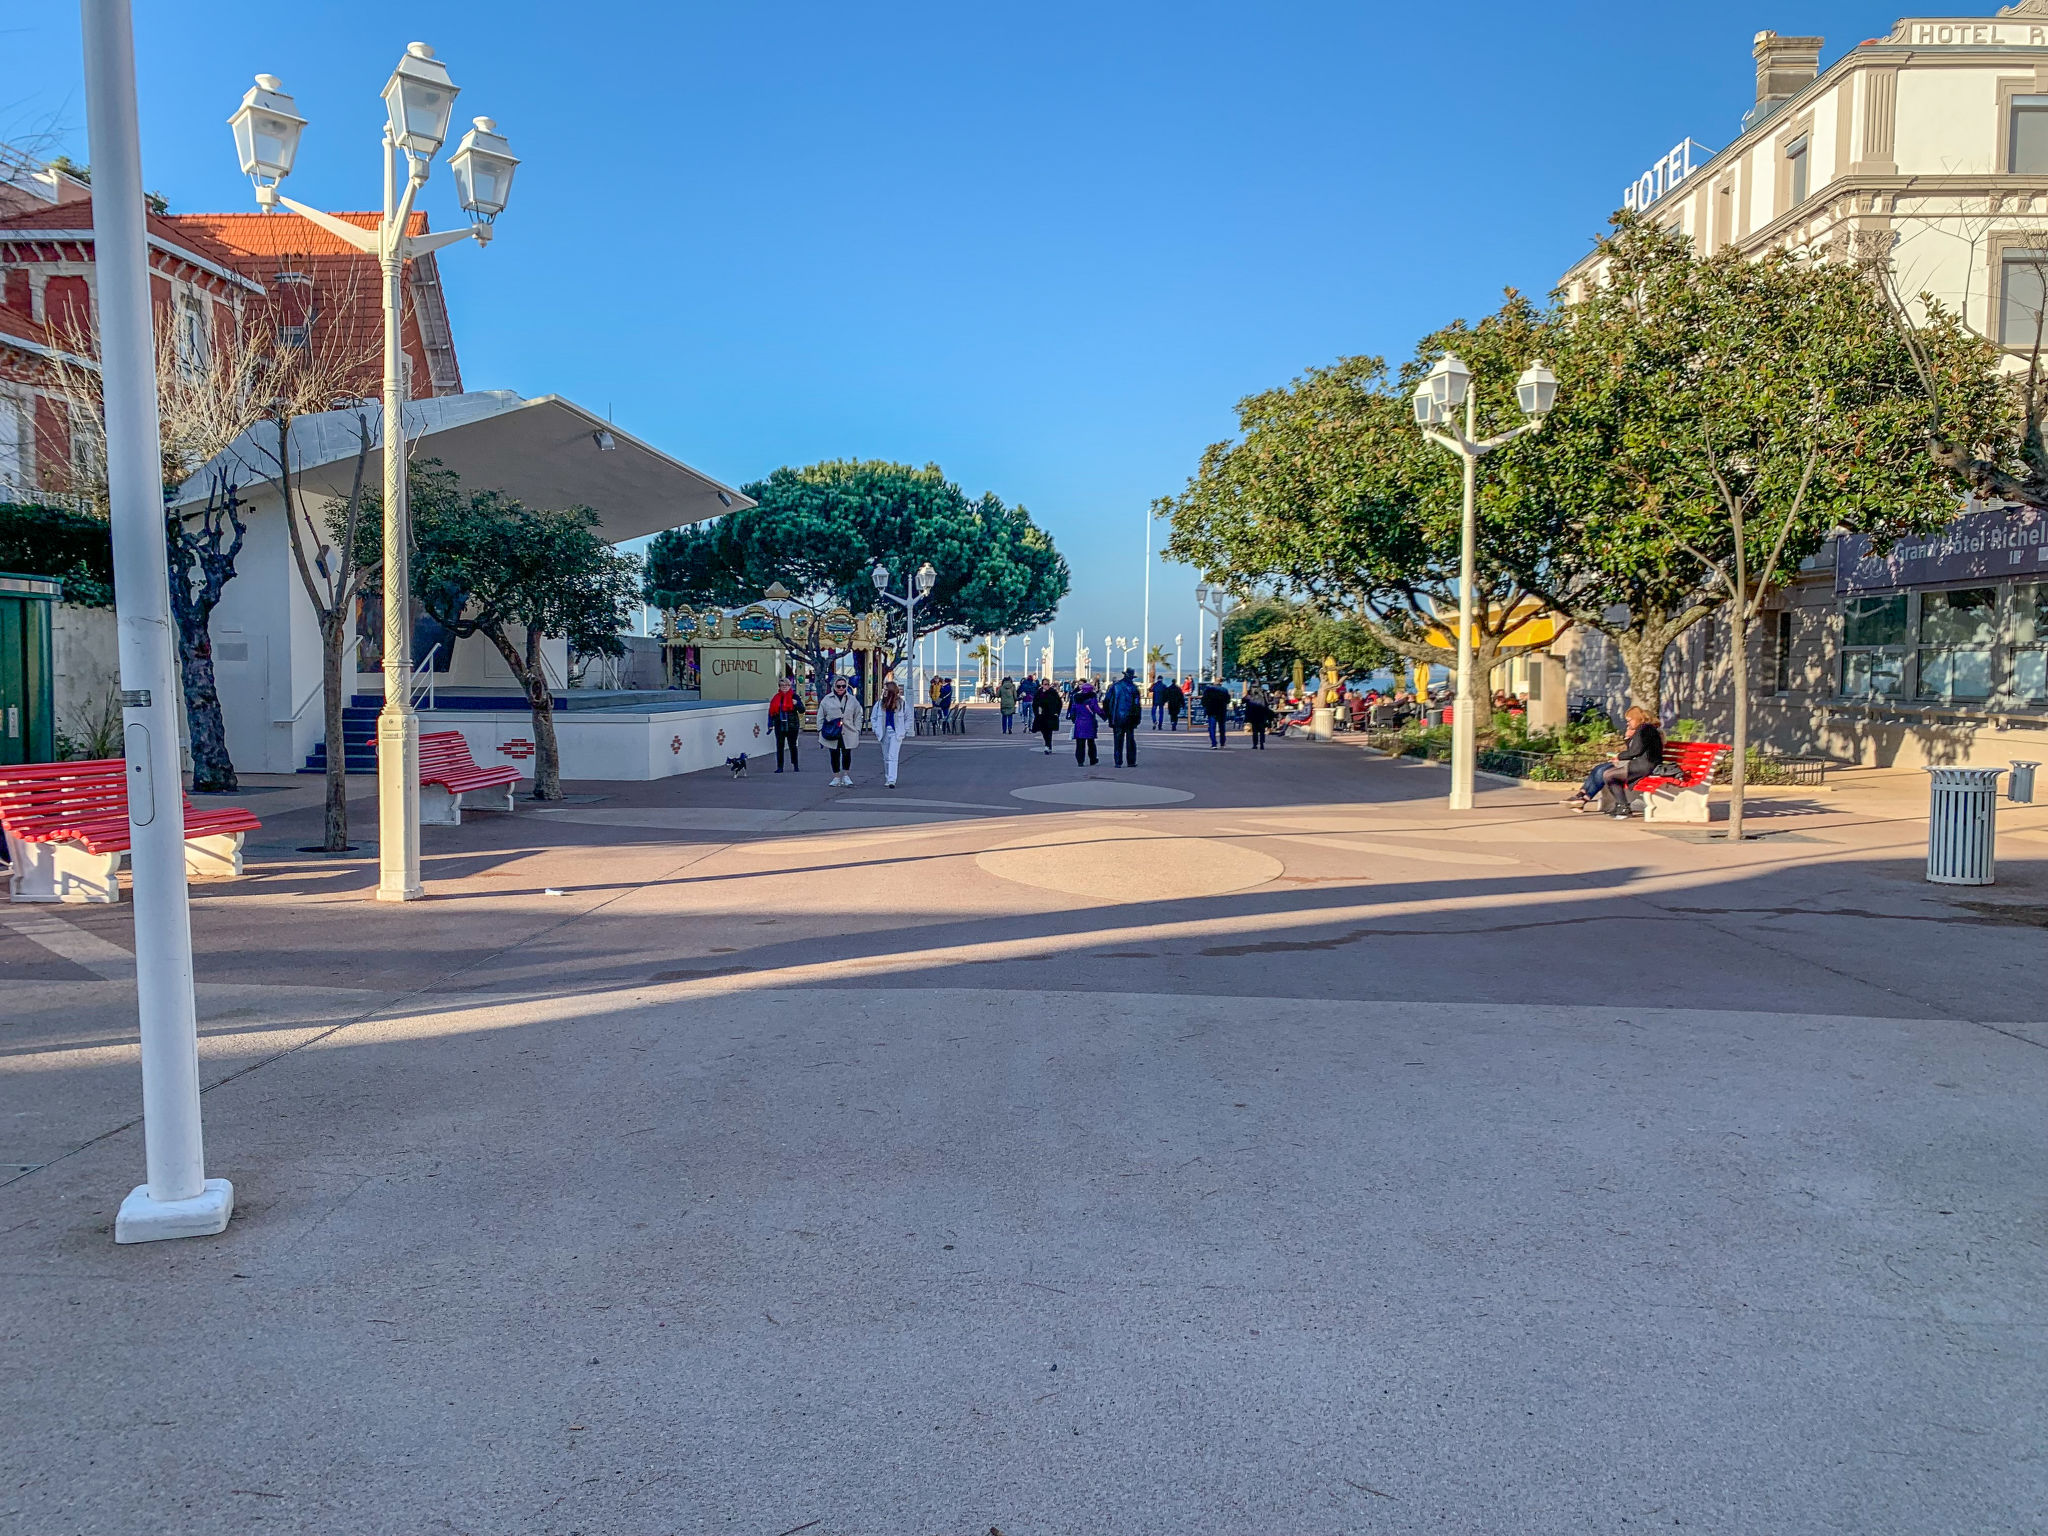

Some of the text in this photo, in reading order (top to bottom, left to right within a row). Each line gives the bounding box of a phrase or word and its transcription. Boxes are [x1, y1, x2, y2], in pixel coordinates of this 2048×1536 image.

[1919, 25, 2005, 44] HOTEL
[1624, 136, 1698, 214] HOTEL
[1990, 520, 2048, 550] Richel
[712, 658, 763, 676] CARAMEL
